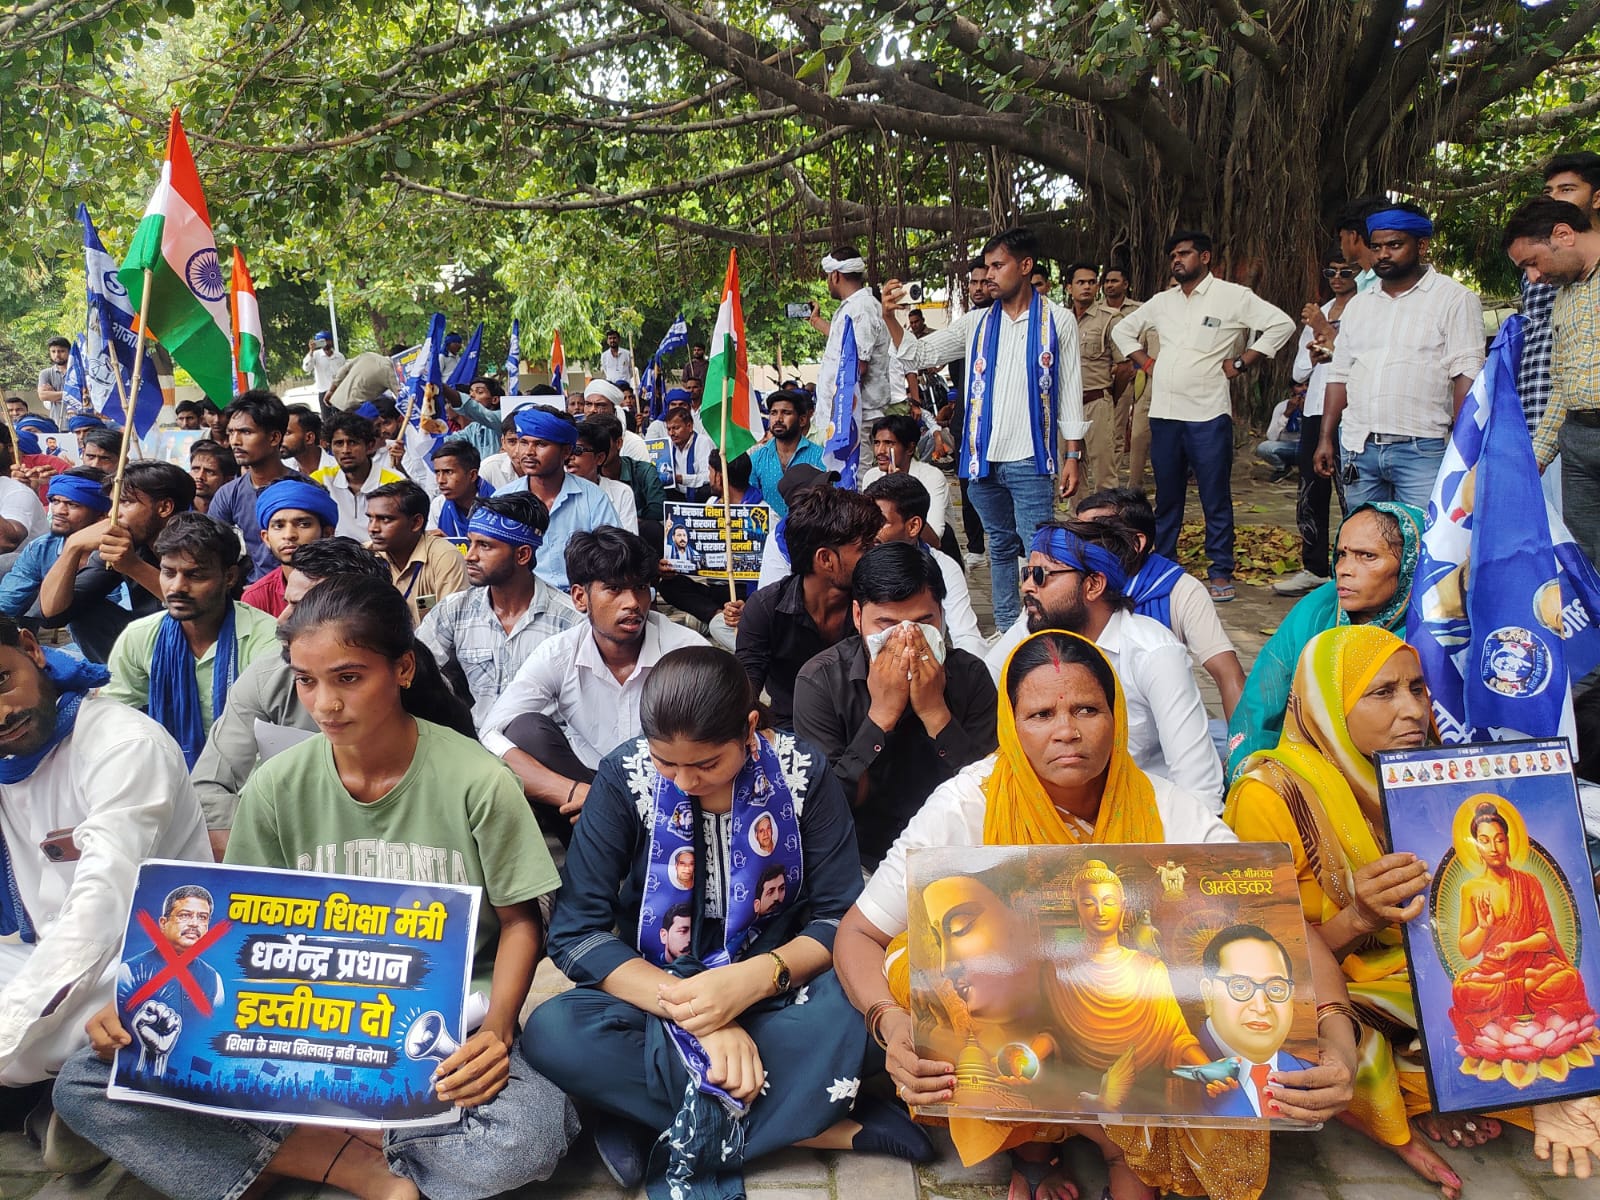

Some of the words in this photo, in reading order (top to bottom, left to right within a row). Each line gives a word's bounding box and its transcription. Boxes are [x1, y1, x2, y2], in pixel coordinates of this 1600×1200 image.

[705, 505, 723, 518] शिक्षा
[731, 540, 752, 552] दलनी
[1199, 872, 1274, 896] अम्बेडकर
[228, 893, 321, 929] नाकाम
[323, 892, 390, 935] शिक्षा
[394, 900, 448, 941] मंत्री
[250, 933, 334, 980] धर्मेन्द्र
[335, 948, 413, 984] प्रधान
[234, 985, 356, 1034] इस्तीफा
[360, 993, 396, 1038] दो
[225, 1034, 255, 1052] शिक्षा
[256, 1036, 268, 1052] के
[269, 1039, 292, 1055] साथ
[293, 1038, 334, 1061] खिलवाड़
[335, 1043, 356, 1060] नहीं
[356, 1046, 389, 1064] चलेगा!
